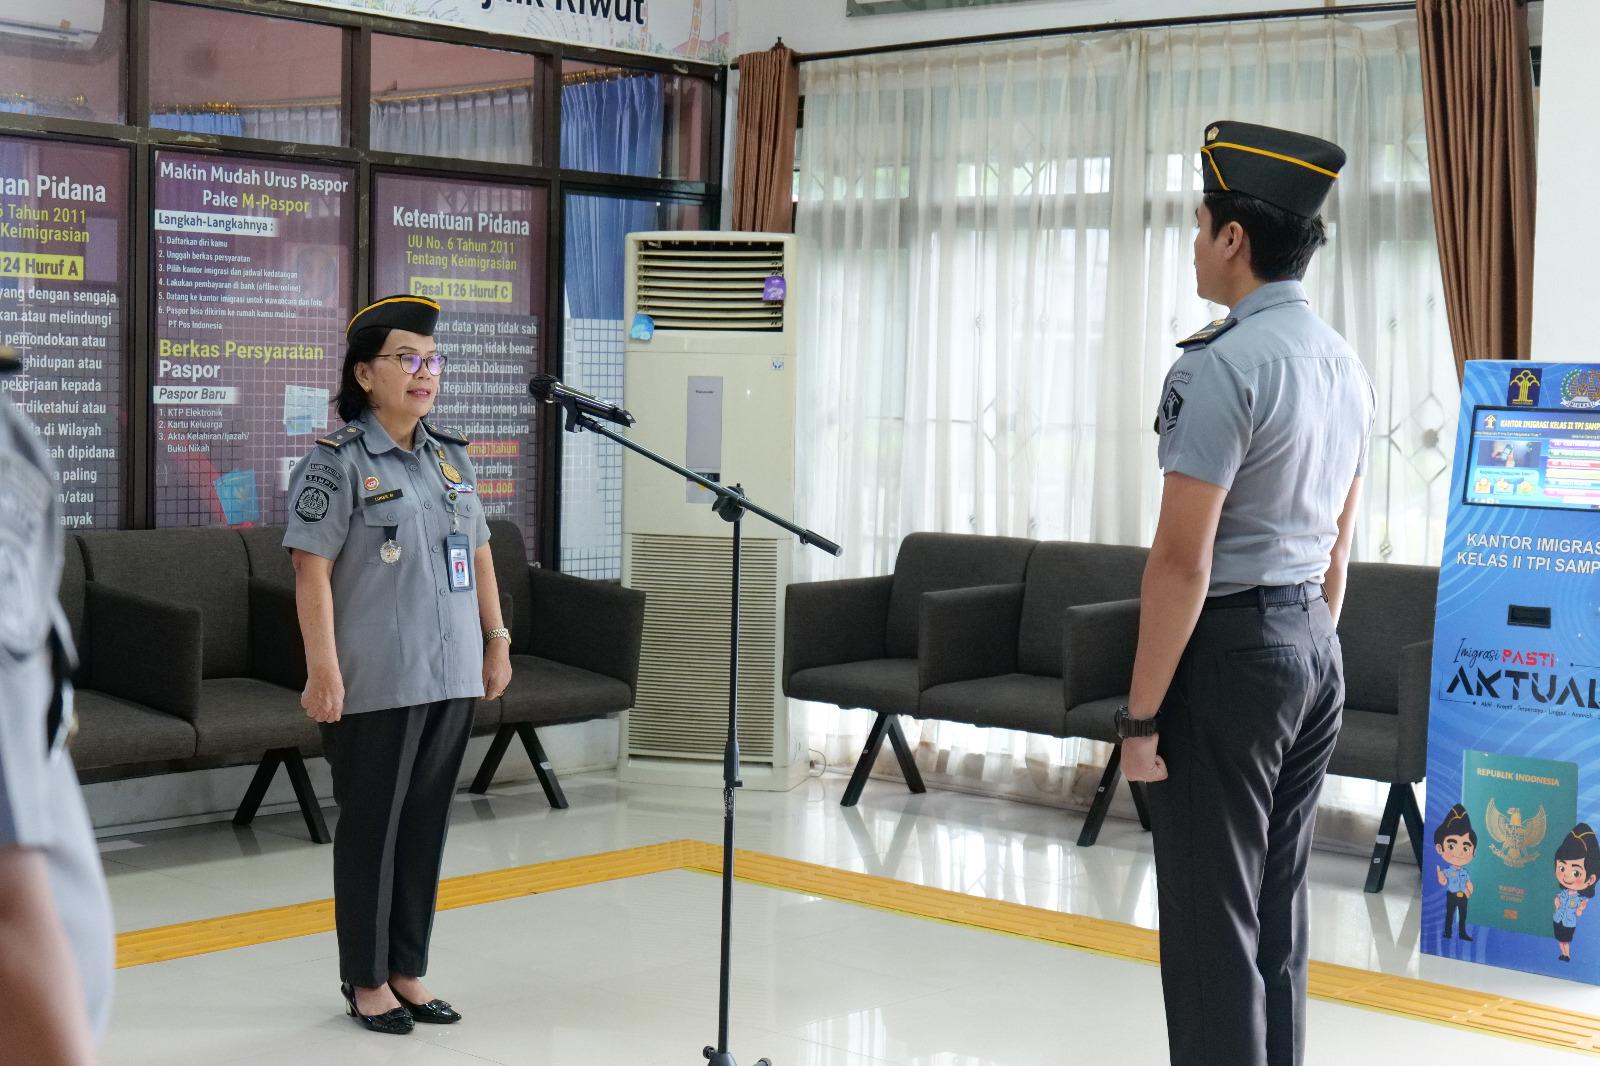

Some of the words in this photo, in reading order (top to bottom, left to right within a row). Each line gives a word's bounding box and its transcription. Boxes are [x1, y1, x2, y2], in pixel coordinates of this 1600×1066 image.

[160, 162, 207, 182] Makin
[211, 166, 260, 187] Mudah
[264, 172, 297, 189] Urus
[301, 174, 348, 196] Paspor
[0, 178, 30, 196] an
[37, 175, 106, 203] Pidana
[203, 190, 239, 208] Pake
[242, 193, 310, 216] M-Paspor
[8, 204, 49, 222] Tahun
[53, 207, 87, 224] 2011
[393, 206, 473, 232] Ketentuan
[478, 213, 530, 236] Pidana
[159, 213, 268, 232] Langkah-Langkahnya
[1, 222, 90, 243] Keimigrasian
[166, 237, 198, 246] Daftarkan
[199, 239, 210, 247] diri
[210, 239, 228, 247] kamu
[408, 234, 423, 249] UU
[426, 235, 444, 249] No.
[447, 237, 454, 250] 6
[457, 238, 487, 253] Tahun
[490, 240, 515, 255] 2011
[166, 251, 191, 261] Unggah
[192, 253, 213, 261] berkas
[214, 254, 251, 264] persyaratan
[406, 251, 448, 269] Tentang
[451, 255, 517, 272] Keimigrasian
[25, 257, 65, 277] Huruf
[68, 264, 79, 277] A
[182, 266, 203, 274] kantor
[230, 267, 242, 275] dan
[242, 268, 263, 277] jadwal
[166, 278, 193, 287] Lakukan
[194, 279, 232, 290] pembayaran
[240, 281, 256, 290] bank
[414, 281, 444, 297] Pasal
[447, 283, 466, 297] 126
[469, 285, 498, 299] Huruf
[501, 286, 509, 299] C
[28, 286, 70, 304] dengan
[73, 290, 117, 306] sengaja
[166, 292, 189, 302] Datang
[190, 293, 198, 301] ke
[21, 310, 46, 323] atau
[49, 311, 112, 328] melindungi
[166, 306, 189, 317] Paspor
[204, 308, 227, 316] dikirim
[227, 308, 236, 316] ke
[236, 309, 256, 317] rumah
[256, 310, 274, 318] kamu
[168, 320, 178, 328] PT
[178, 320, 191, 329] Pos
[452, 320, 472, 332] data
[474, 323, 495, 335] yang
[497, 321, 520, 334] tidak
[521, 322, 537, 335] sah
[5, 333, 78, 347] pemondokan
[82, 335, 106, 347] atau
[159, 339, 220, 358] Berkas
[225, 340, 324, 364] Persyaratan
[436, 342, 459, 355] ngan
[461, 344, 483, 356] yang
[485, 342, 508, 354] tidak
[509, 342, 535, 355] benar
[78, 357, 102, 369] atau
[159, 359, 221, 382] Paspor
[483, 362, 524, 374] Dokumen
[2, 377, 58, 394] pekerjaan
[61, 378, 102, 394] kepada
[443, 382, 484, 396] Republik
[485, 383, 527, 394] Indonesia
[159, 387, 199, 402] Paspor
[201, 388, 227, 400] Baru
[26, 400, 79, 415] diketahui
[82, 401, 107, 414] atau
[159, 408, 166, 417] 1.
[168, 409, 184, 417] KTP
[186, 408, 223, 417] Elektronik
[438, 402, 469, 415] sendiri
[471, 404, 491, 415] atau
[492, 405, 518, 417] orang
[520, 402, 536, 415] lain
[44, 423, 55, 436] di
[58, 422, 102, 439] Wilayah
[158, 420, 166, 429] 2.
[168, 421, 189, 429] Kartu
[190, 421, 223, 431] Keluarga
[465, 422, 495, 435] pidana
[497, 424, 530, 437] penjara
[158, 432, 166, 440] 3.
[168, 433, 186, 441] Akta
[67, 445, 115, 462] dipidana
[167, 444, 188, 453] Buku
[188, 444, 210, 453] Nikah
[62, 468, 98, 484] paling
[486, 462, 513, 477] paling
[307, 475, 337, 490] SAMPIT
[58, 511, 93, 529] anyak
[1467, 533, 1532, 550] KANTOR
[1537, 538, 1600, 555] IMIGRAS
[1456, 551, 1508, 568] KELAS
[1513, 555, 1522, 569] II
[1527, 557, 1551, 571] TPI
[1555, 558, 1600, 574] SAMP
[1453, 638, 1499, 668] Imigrasi
[1502, 649, 1555, 668] PASTI
[1446, 665, 1600, 708] AKTUAL
[1476, 767, 1514, 781] REPUBLIK
[1516, 772, 1560, 787] INDONESIA
